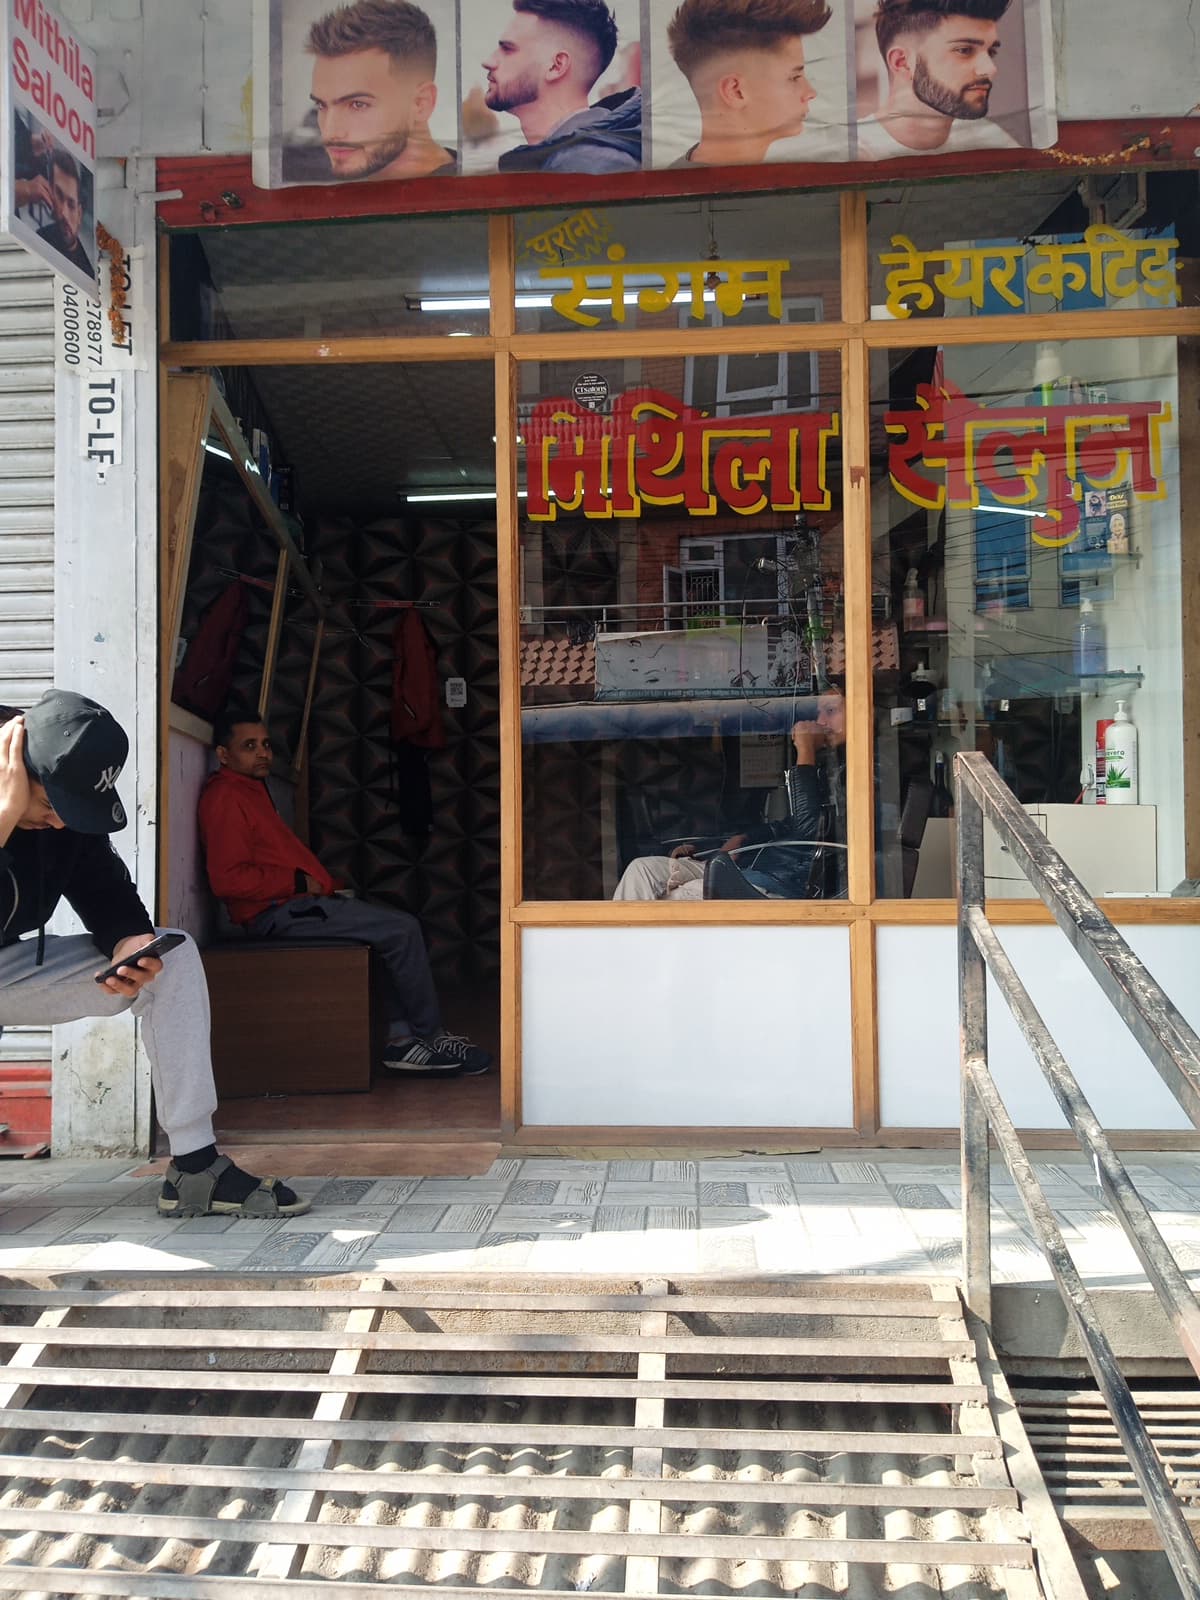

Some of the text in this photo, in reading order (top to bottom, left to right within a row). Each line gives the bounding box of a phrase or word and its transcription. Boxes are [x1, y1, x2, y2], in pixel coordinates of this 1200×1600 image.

[13, 36, 95, 161] Saloon
[14, 0, 94, 103] Mithila
[539, 243, 790, 327] संगम
[879, 234, 1025, 320] हेयर
[87, 377, 116, 479] TO-LE
[520, 388, 839, 521] मिथिला
